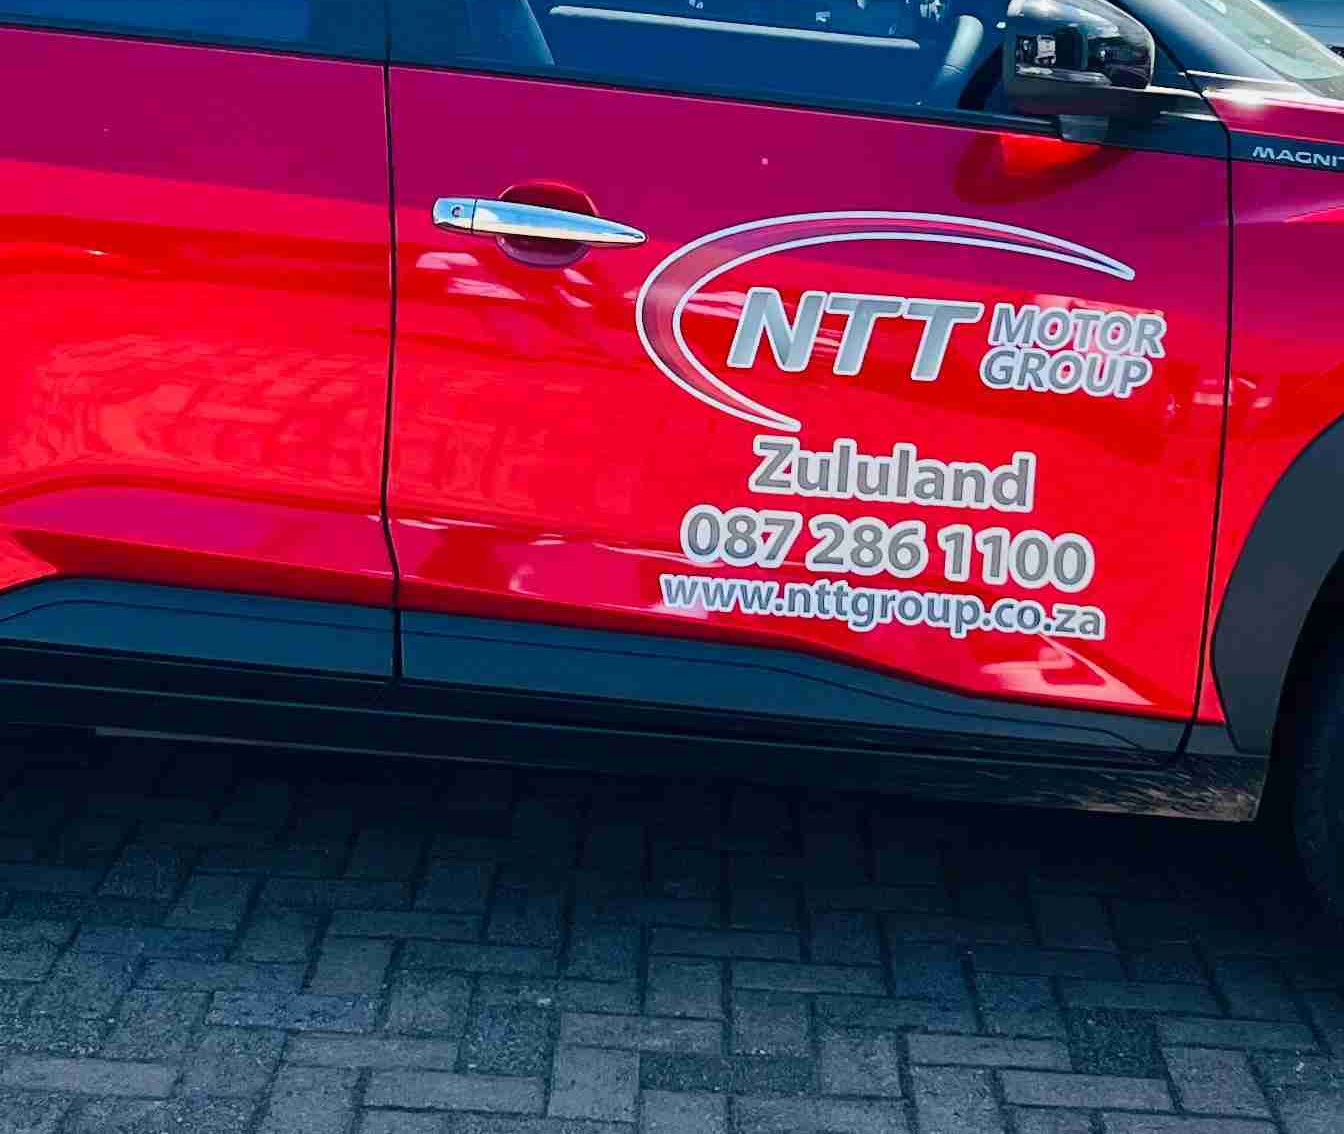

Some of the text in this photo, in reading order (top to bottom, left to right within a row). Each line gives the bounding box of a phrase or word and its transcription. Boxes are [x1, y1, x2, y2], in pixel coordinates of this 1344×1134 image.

[726, 287, 984, 381] NTT
[988, 304, 1166, 357] MOTOR
[981, 350, 1152, 398] GROUP
[749, 434, 1036, 513] Zululand
[680, 504, 1096, 593] 087 286 1100
[660, 574, 1106, 640] www.nttgroup.co.za
